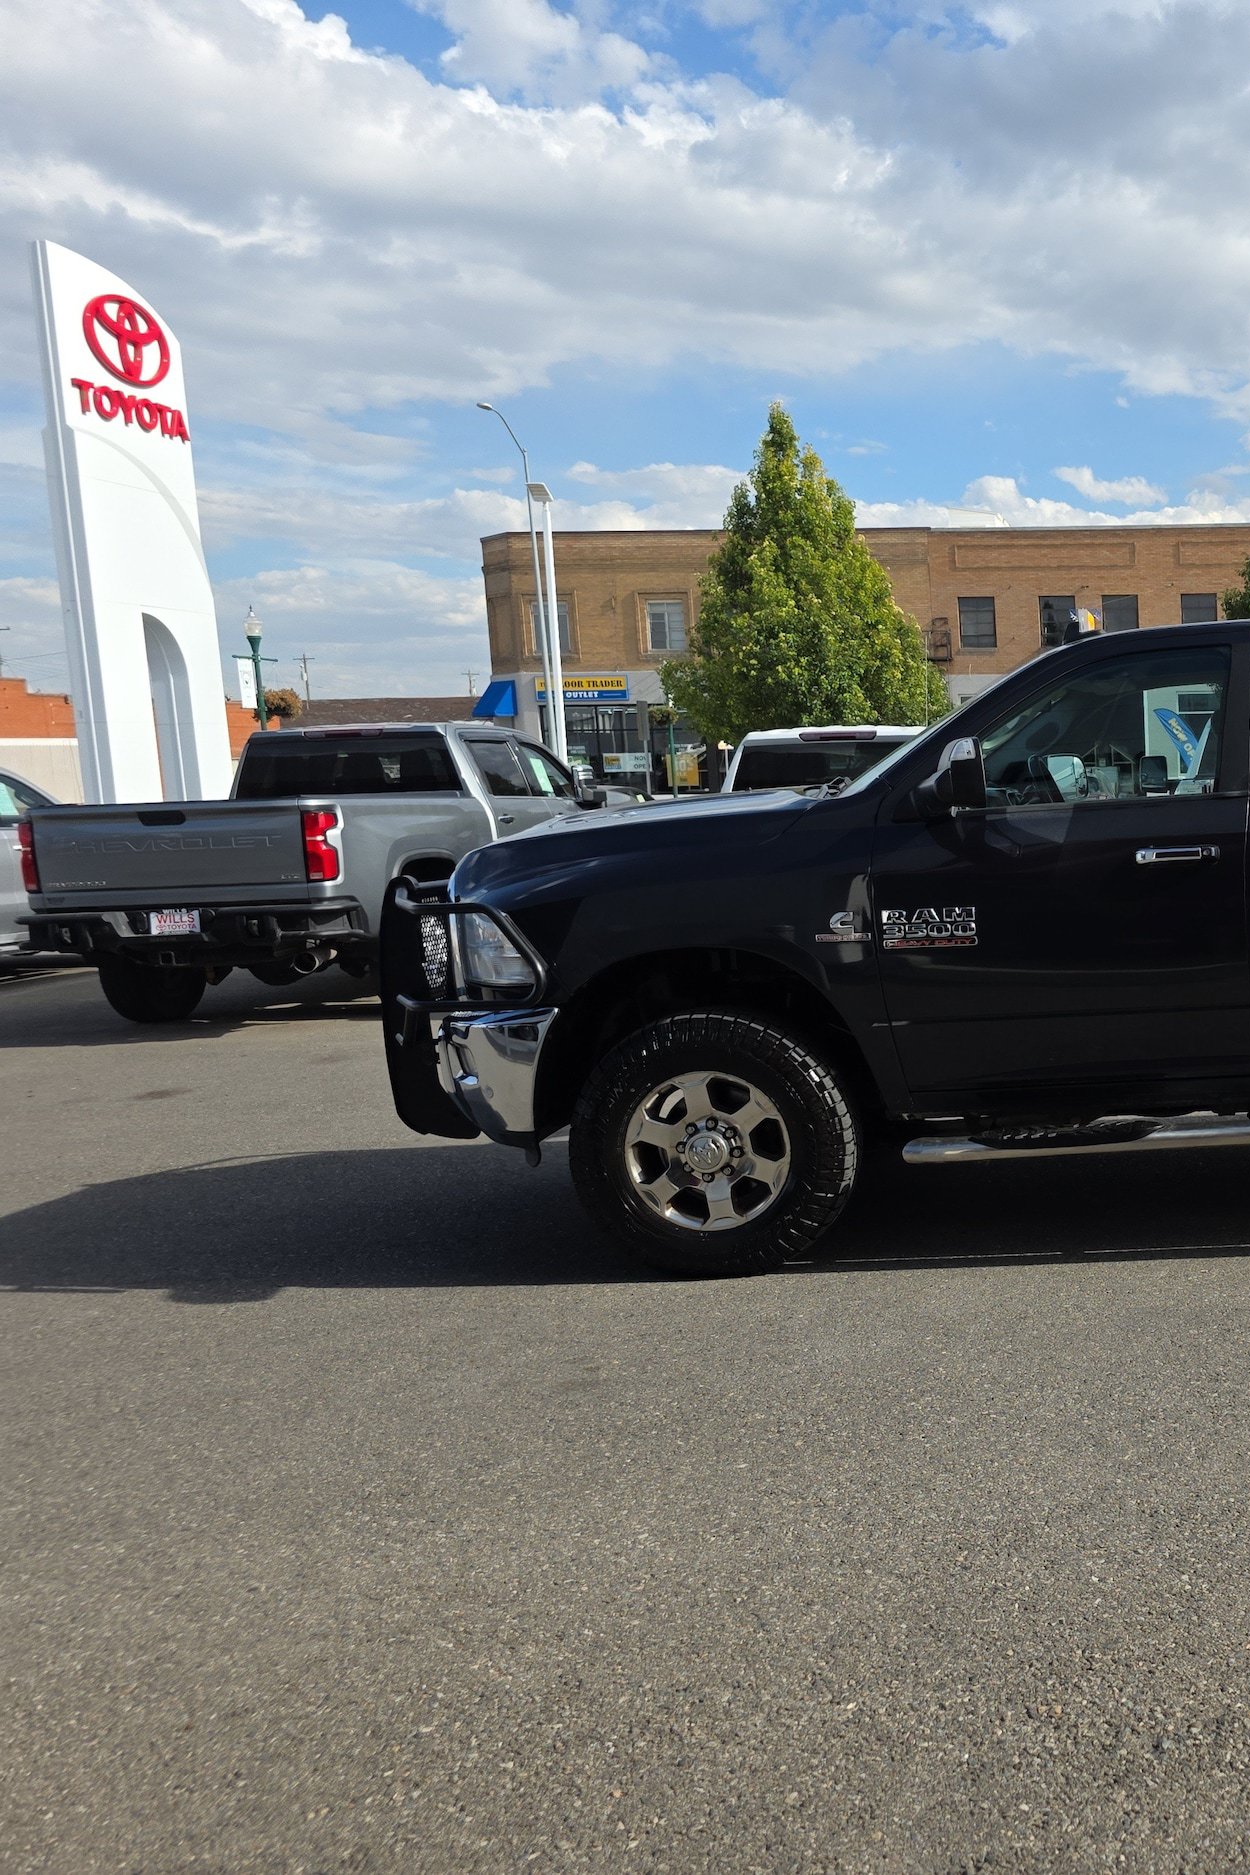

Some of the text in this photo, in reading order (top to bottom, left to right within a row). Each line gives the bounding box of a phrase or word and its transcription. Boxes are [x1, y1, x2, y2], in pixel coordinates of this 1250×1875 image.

[70, 378, 190, 444] TOYOTA
[563, 679, 623, 688] OOR TRADER
[1168, 718, 1188, 741] NOW
[156, 914, 195, 923] WILLS
[881, 907, 975, 923] RAM
[883, 922, 976, 938] 3500
[886, 940, 931, 948] HEAVY
